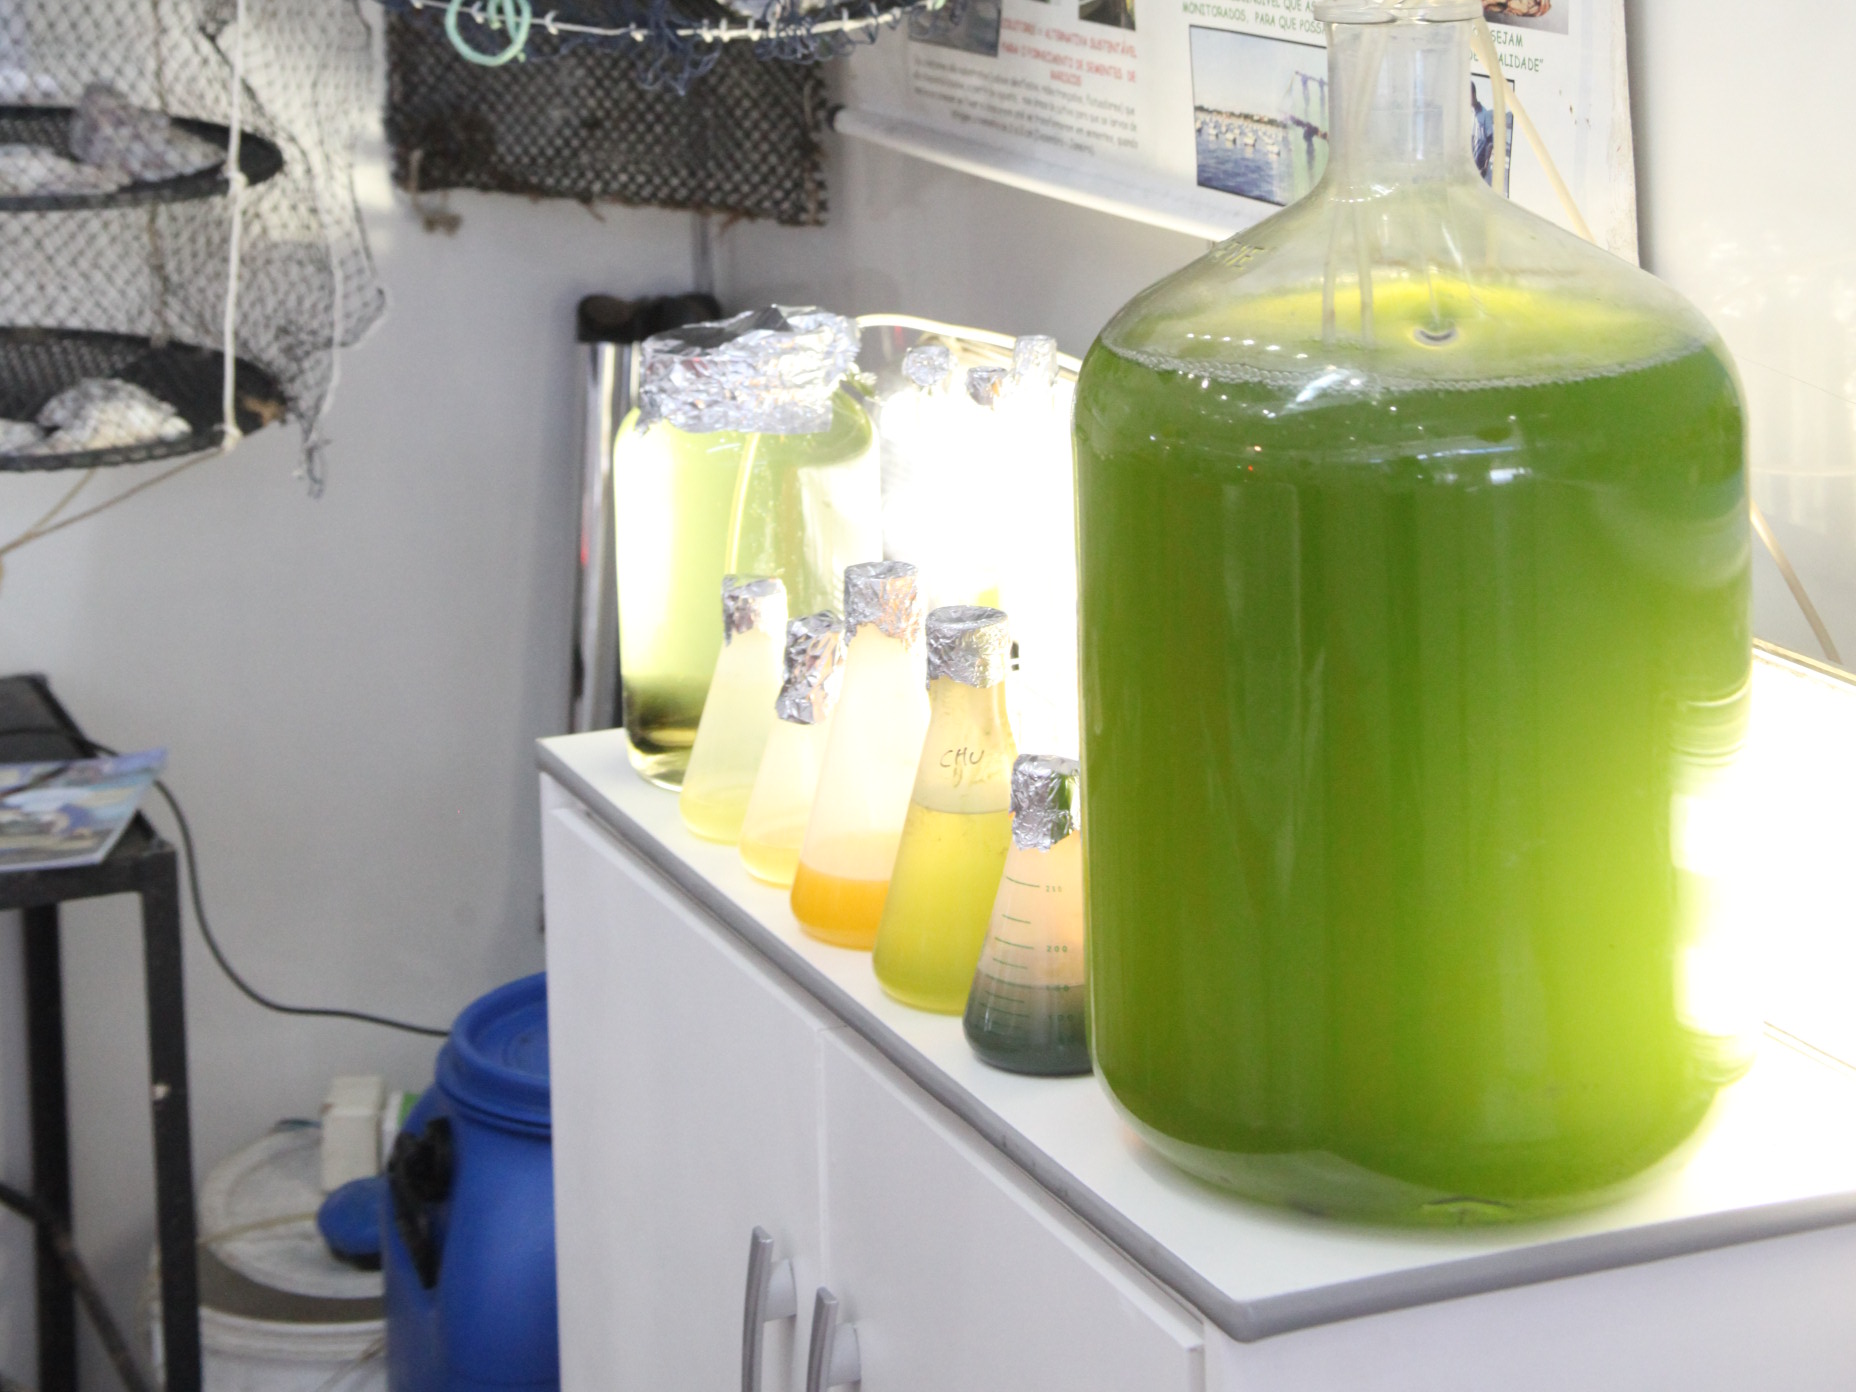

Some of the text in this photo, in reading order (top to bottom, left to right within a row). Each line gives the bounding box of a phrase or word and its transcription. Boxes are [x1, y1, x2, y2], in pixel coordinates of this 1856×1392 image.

[1255, 11, 1275, 26] PARA
[1279, 15, 1296, 30] QUE
[1490, 29, 1523, 47] SEJAM
[940, 747, 984, 768] CHU
